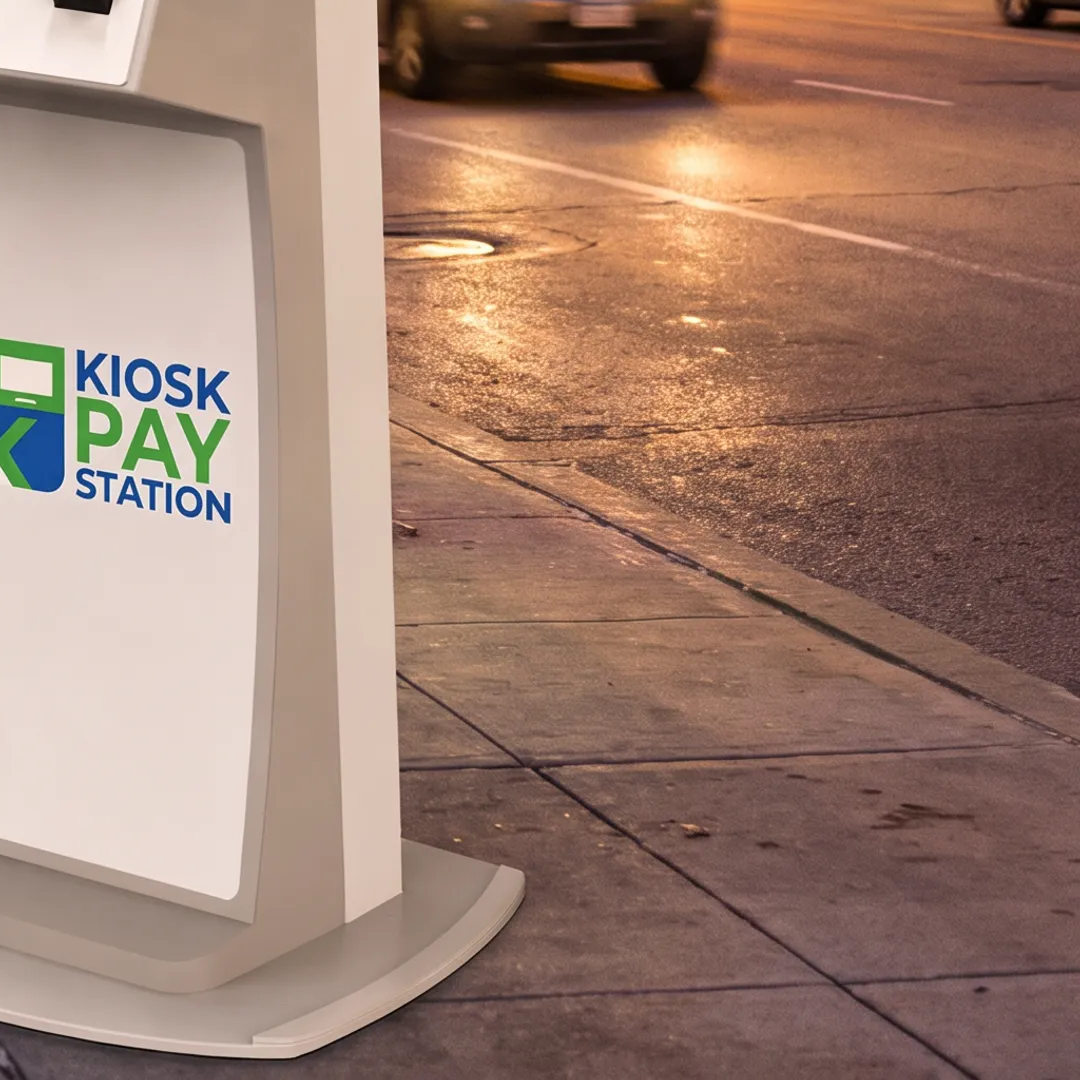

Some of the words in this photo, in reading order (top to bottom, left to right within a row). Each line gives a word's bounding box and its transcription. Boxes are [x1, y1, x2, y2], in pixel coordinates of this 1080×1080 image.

[76, 349, 231, 415] KIOSK
[76, 396, 231, 484] PAY
[75, 467, 231, 524] STATION
